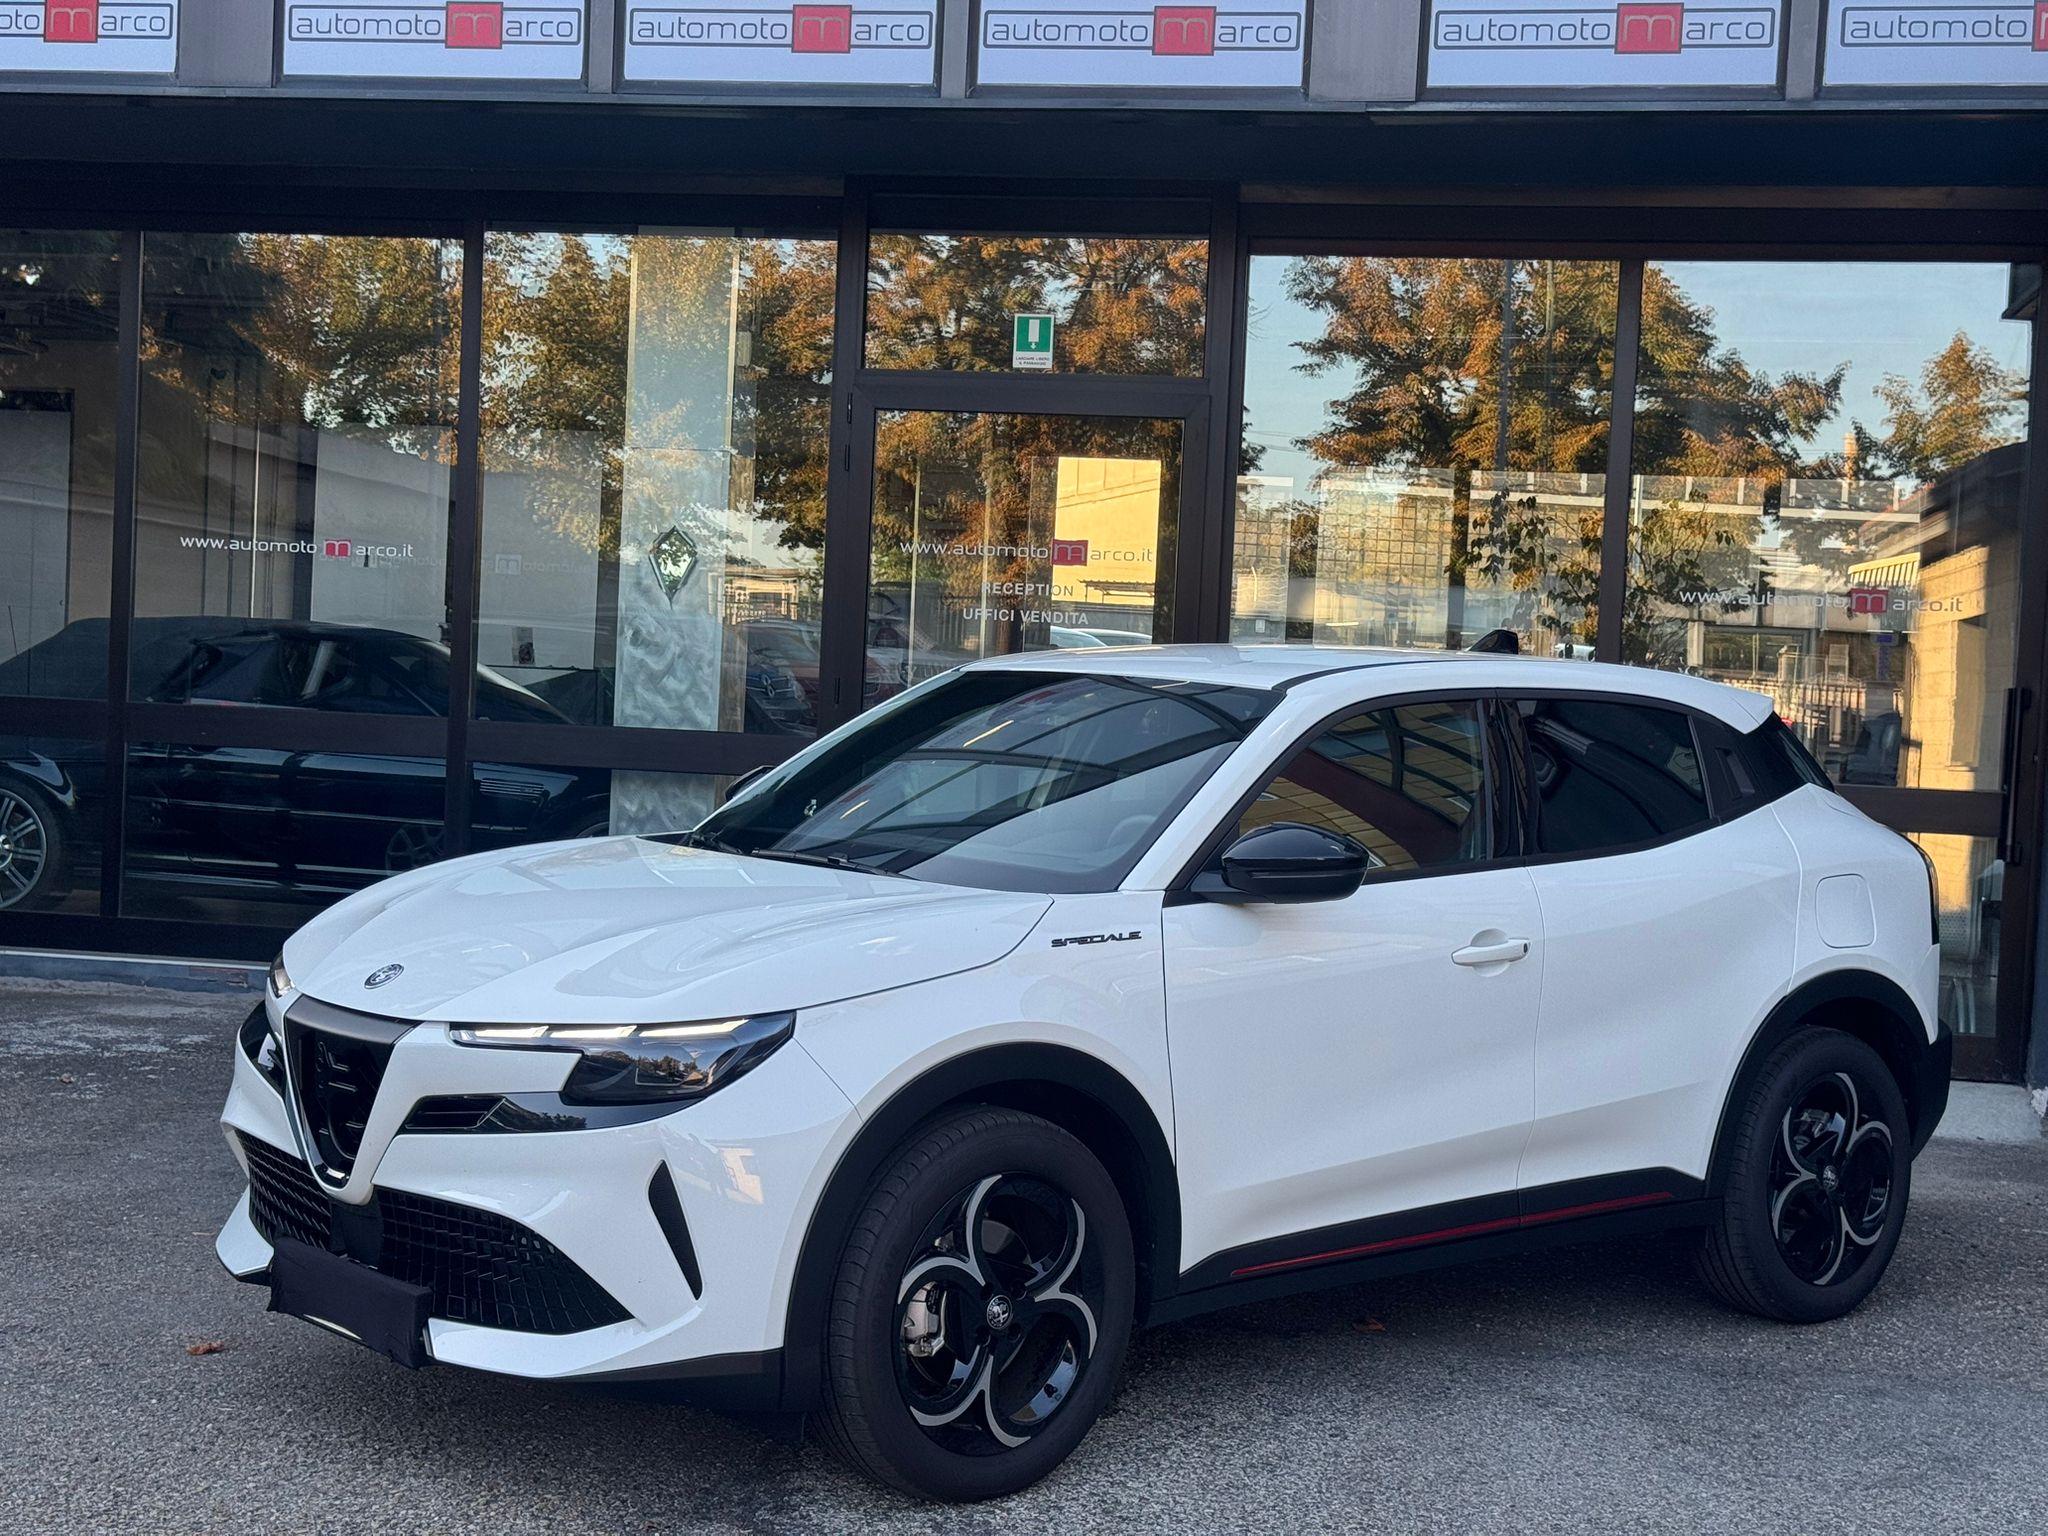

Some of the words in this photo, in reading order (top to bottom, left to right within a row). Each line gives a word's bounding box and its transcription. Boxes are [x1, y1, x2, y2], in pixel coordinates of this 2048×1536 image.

[981, 582, 1074, 597] RECEPTION
[963, 607, 1015, 622] UFFICI
[1021, 610, 1089, 625] VENDITA
[1051, 930, 1142, 948] SPECIALE
